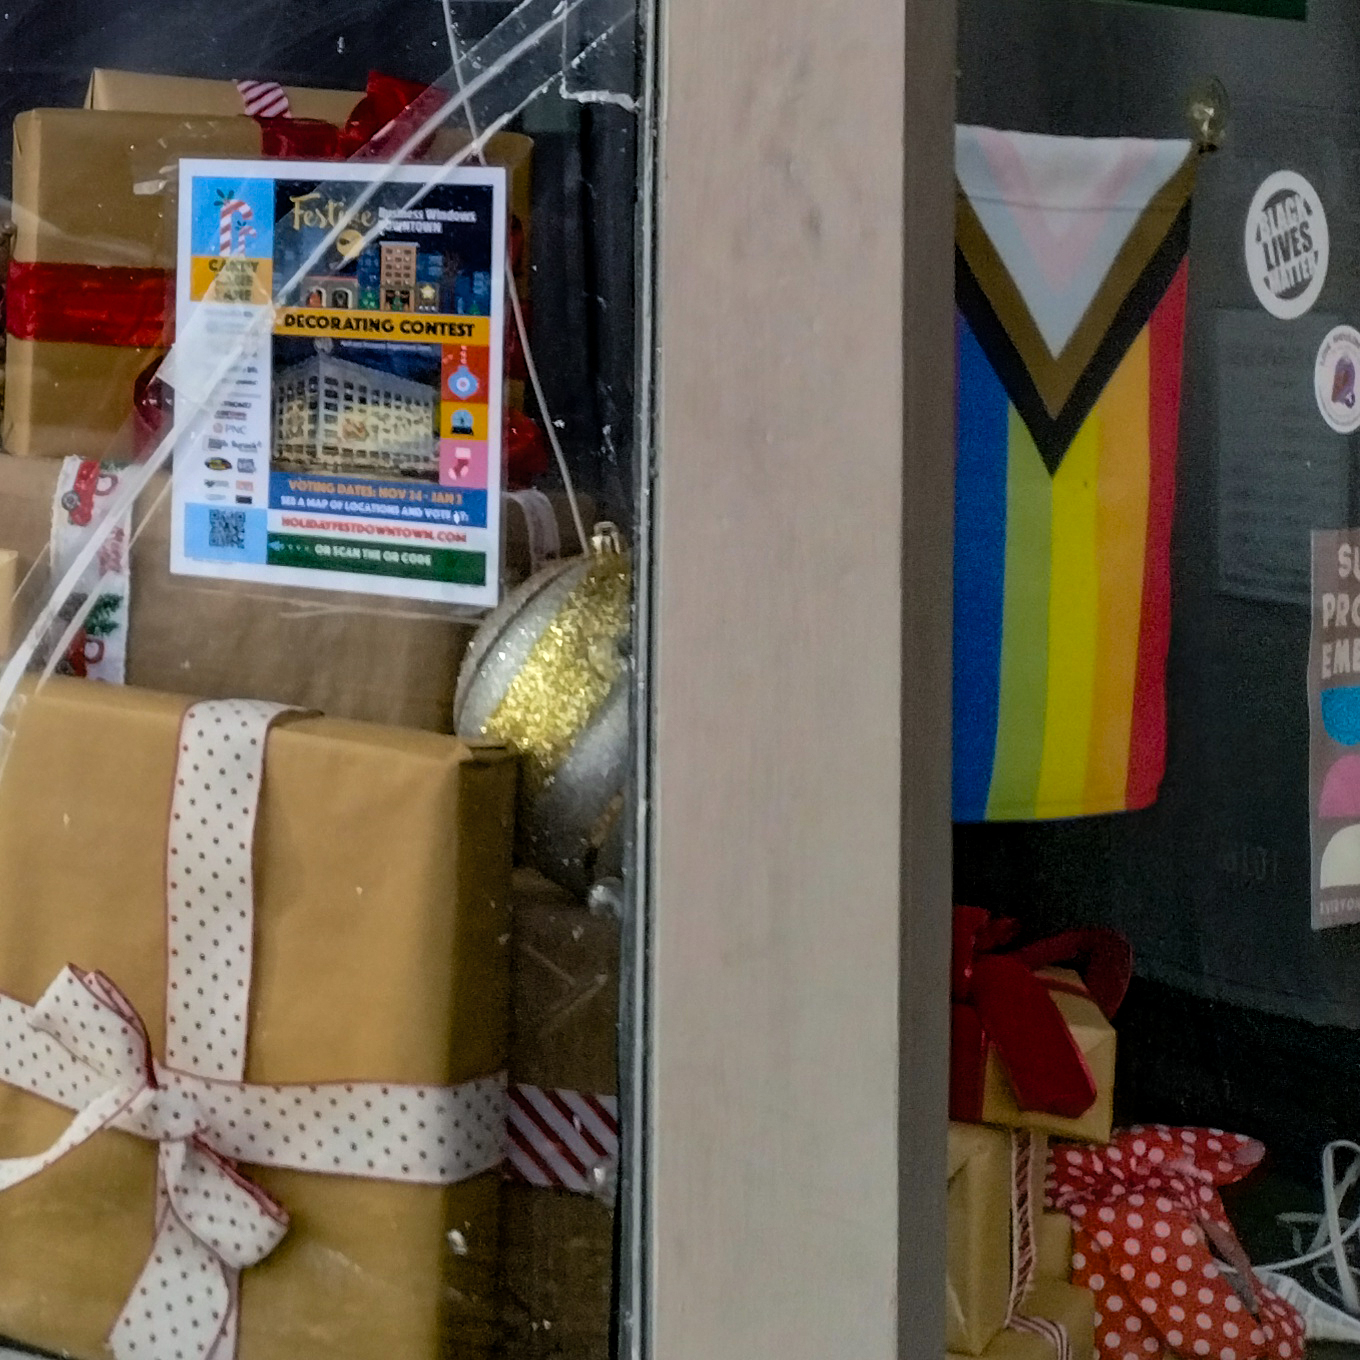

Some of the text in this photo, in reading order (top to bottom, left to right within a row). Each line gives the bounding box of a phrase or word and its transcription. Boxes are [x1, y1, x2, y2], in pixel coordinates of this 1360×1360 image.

[289, 192, 374, 231] Festie
[1262, 220, 1313, 271] LIVES
[284, 313, 475, 338] DECORATING CONTEST
[289, 479, 334, 493] VOTING
[401, 506, 423, 517] AND
